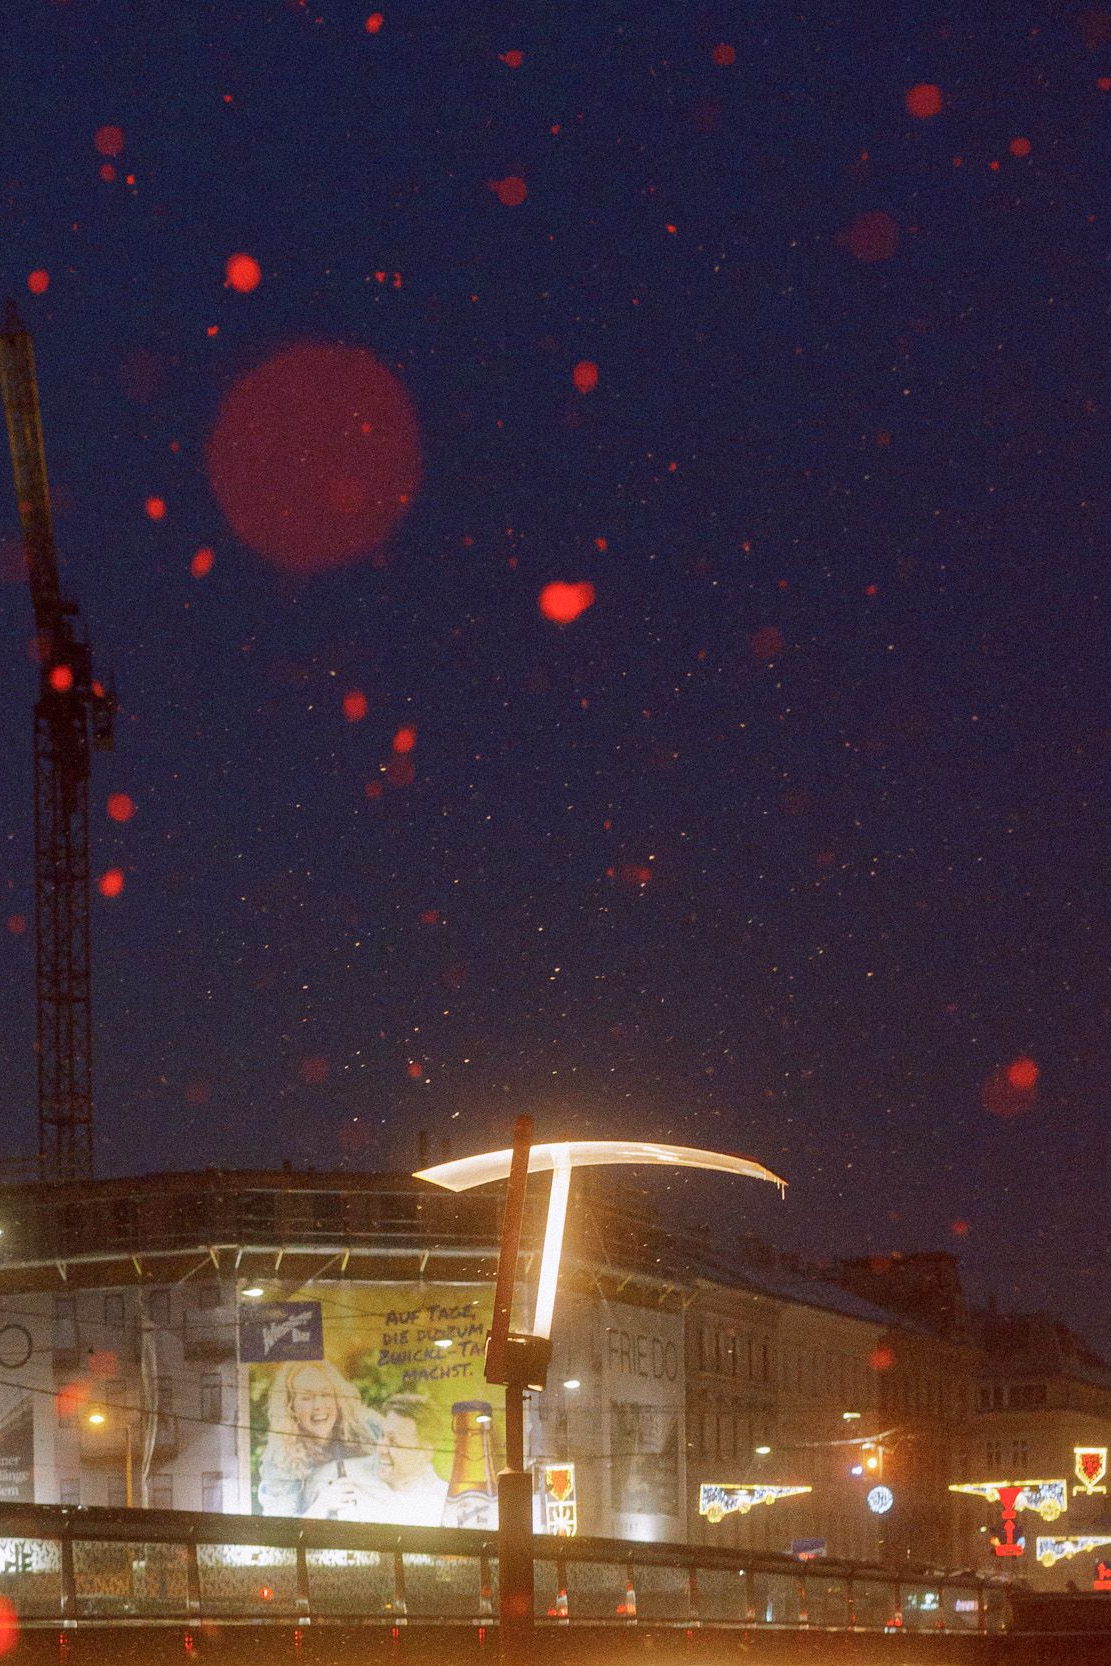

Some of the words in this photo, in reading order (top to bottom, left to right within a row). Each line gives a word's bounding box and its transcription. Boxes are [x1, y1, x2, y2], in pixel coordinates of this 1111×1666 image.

[385, 1309, 418, 1326] AUF
[382, 1329, 409, 1346] DIE
[446, 1323, 484, 1338] ZUM
[377, 1340, 486, 1369] ZWICKL-TA
